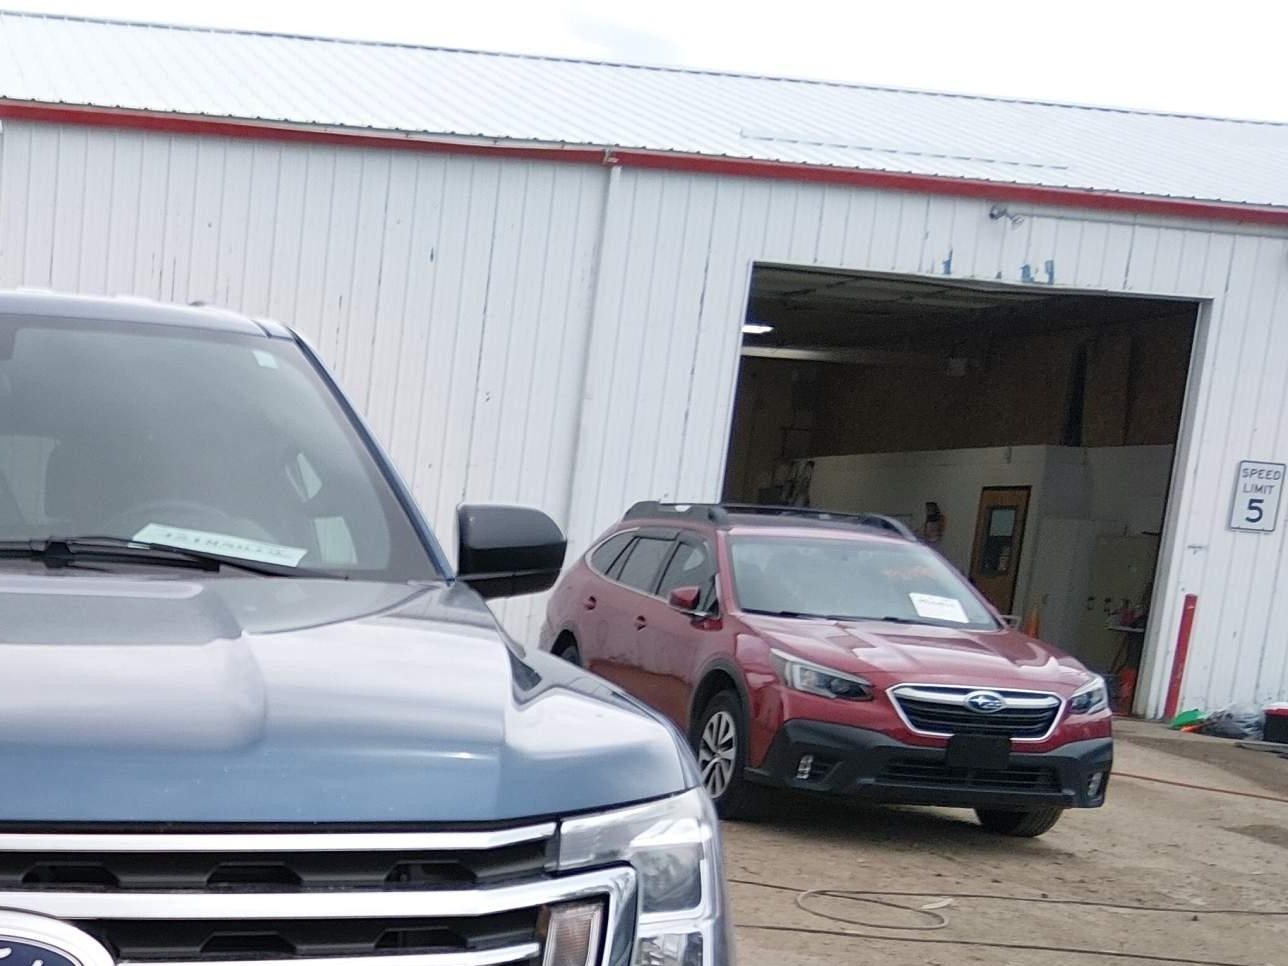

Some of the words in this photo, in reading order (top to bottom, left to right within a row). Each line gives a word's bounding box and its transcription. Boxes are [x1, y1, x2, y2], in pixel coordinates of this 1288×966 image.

[1242, 467, 1282, 481] SPEED
[1242, 482, 1275, 495] LIMIT
[1245, 498, 1265, 523] 5
